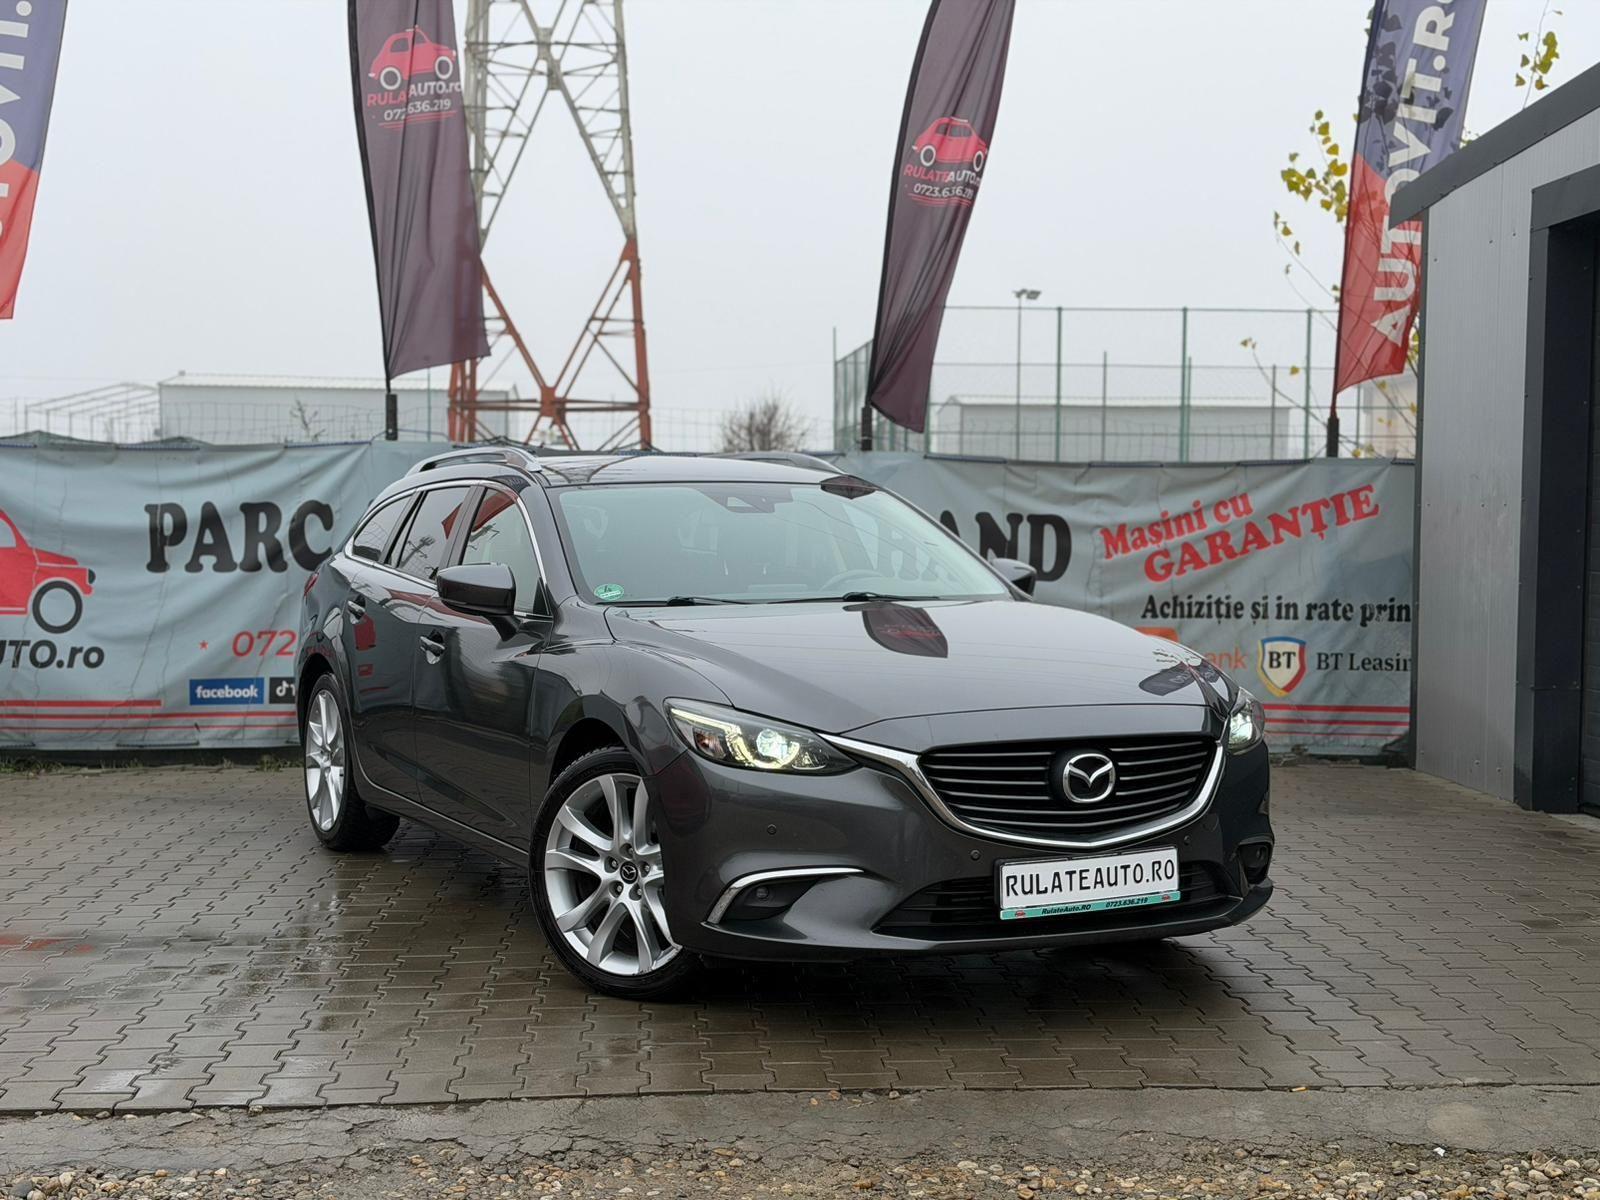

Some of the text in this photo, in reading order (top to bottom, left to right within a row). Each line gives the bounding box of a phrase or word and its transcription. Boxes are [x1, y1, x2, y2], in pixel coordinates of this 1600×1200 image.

[1371, 0, 1455, 347] AUTVIT.R
[144, 501, 334, 573] PARC
[1100, 493, 1254, 560] Mașini cu
[1144, 484, 1381, 582] GARANȚIE
[1141, 594, 1411, 628] Achiziție și in rate prin
[0, 639, 105, 669] TO.ro
[1268, 651, 1296, 669] BT
[1316, 652, 1343, 670] BT
[195, 684, 259, 698] facebook
[1005, 859, 1175, 897] RULATEAUTO.RO
